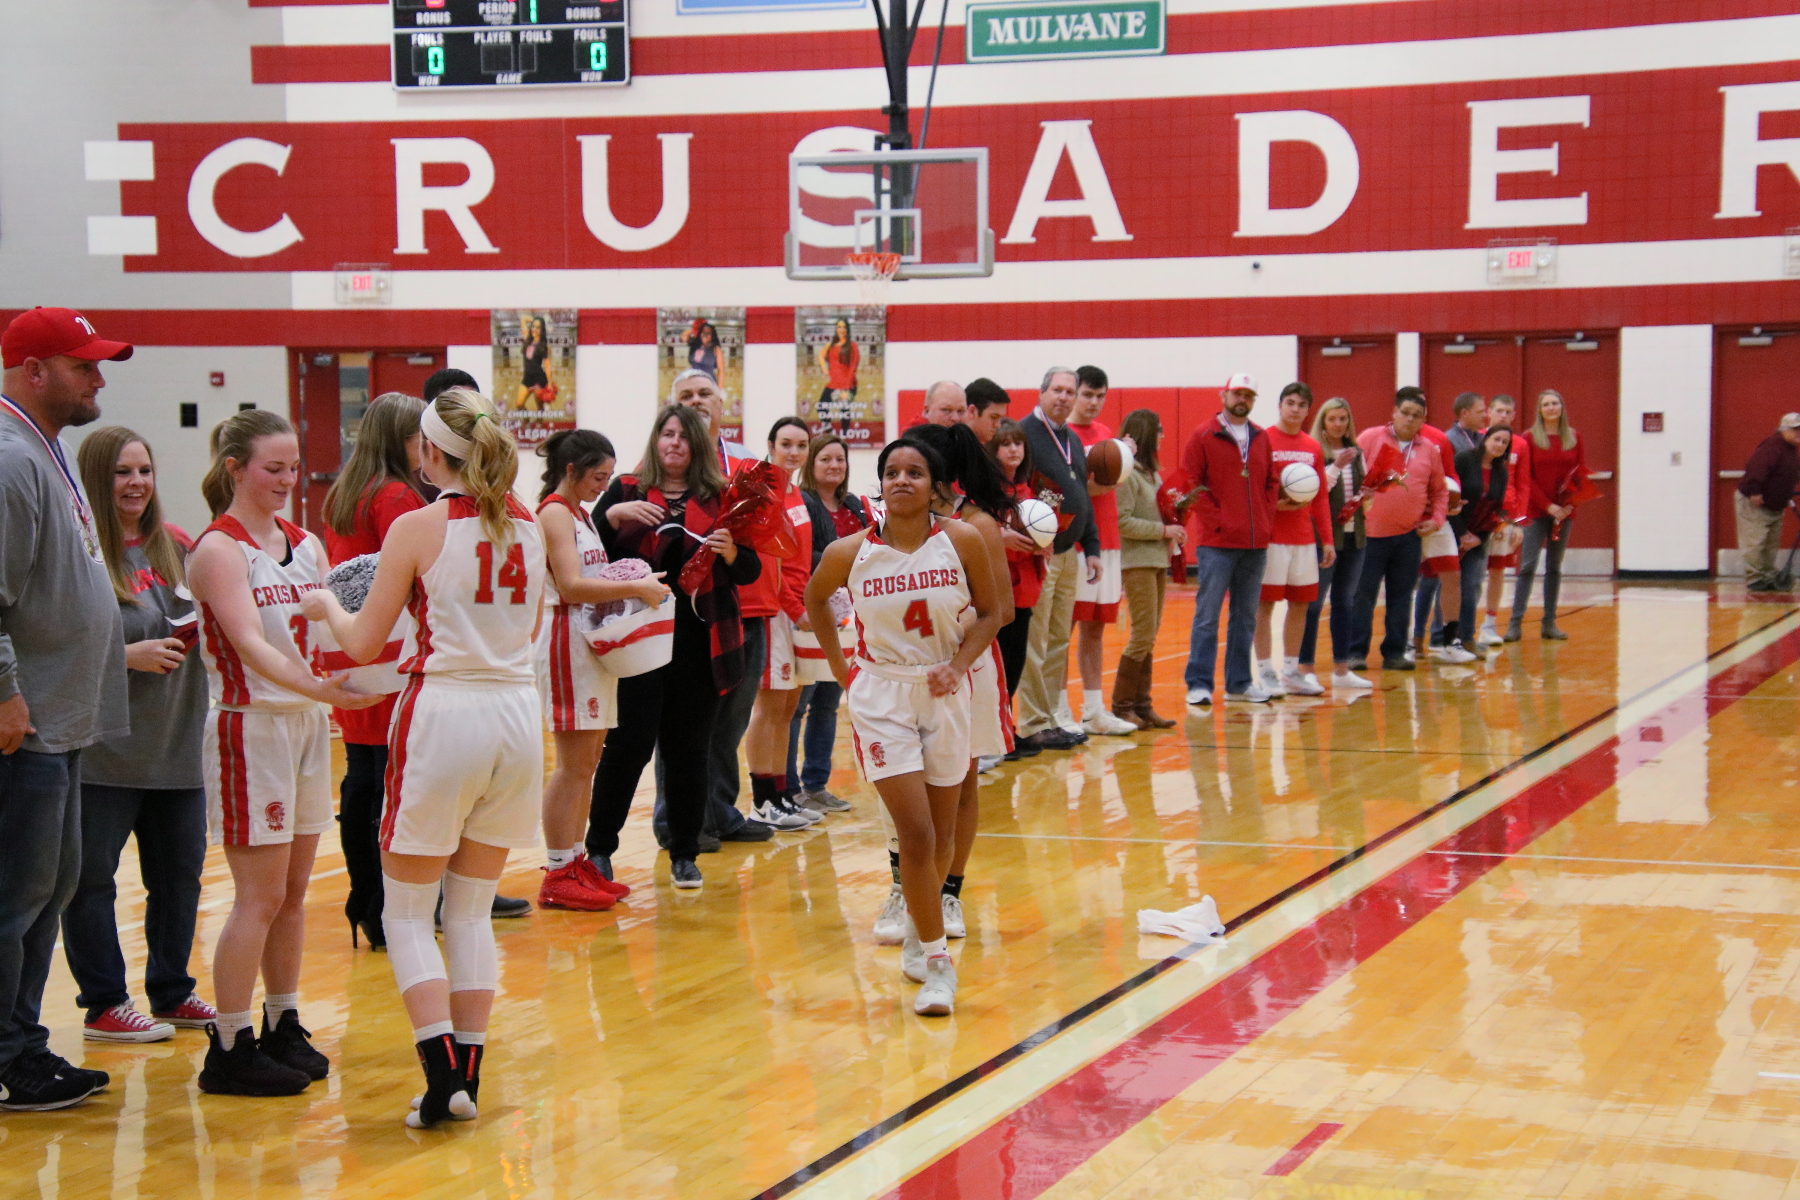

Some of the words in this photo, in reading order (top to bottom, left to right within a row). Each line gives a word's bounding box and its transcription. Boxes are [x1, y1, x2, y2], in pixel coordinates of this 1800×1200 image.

[478, 2, 517, 15] PERIOD
[565, 6, 602, 21] BONUS
[416, 11, 452, 25] BONUS
[573, 27, 607, 42] FOULS
[987, 11, 1147, 45] MULVANE
[411, 32, 445, 47] FOULS
[473, 31, 513, 45] PLAYER
[519, 29, 553, 43] FOULS
[427, 46, 445, 75] 0
[590, 42, 607, 71] 0
[418, 75, 440, 87] WON
[496, 72, 523, 85] GAME
[580, 71, 603, 82] WON
[1508, 251, 1532, 269] EXIT
[352, 275, 372, 291] EXIT
[814, 401, 868, 411] CRIMSON
[818, 410, 865, 420] DANCER
[517, 427, 562, 441] LEGRA
[474, 541, 529, 605] 14
[862, 568, 959, 598] CRUSADERS
[252, 582, 322, 608] CRUSA
[902, 597, 935, 639] 4
